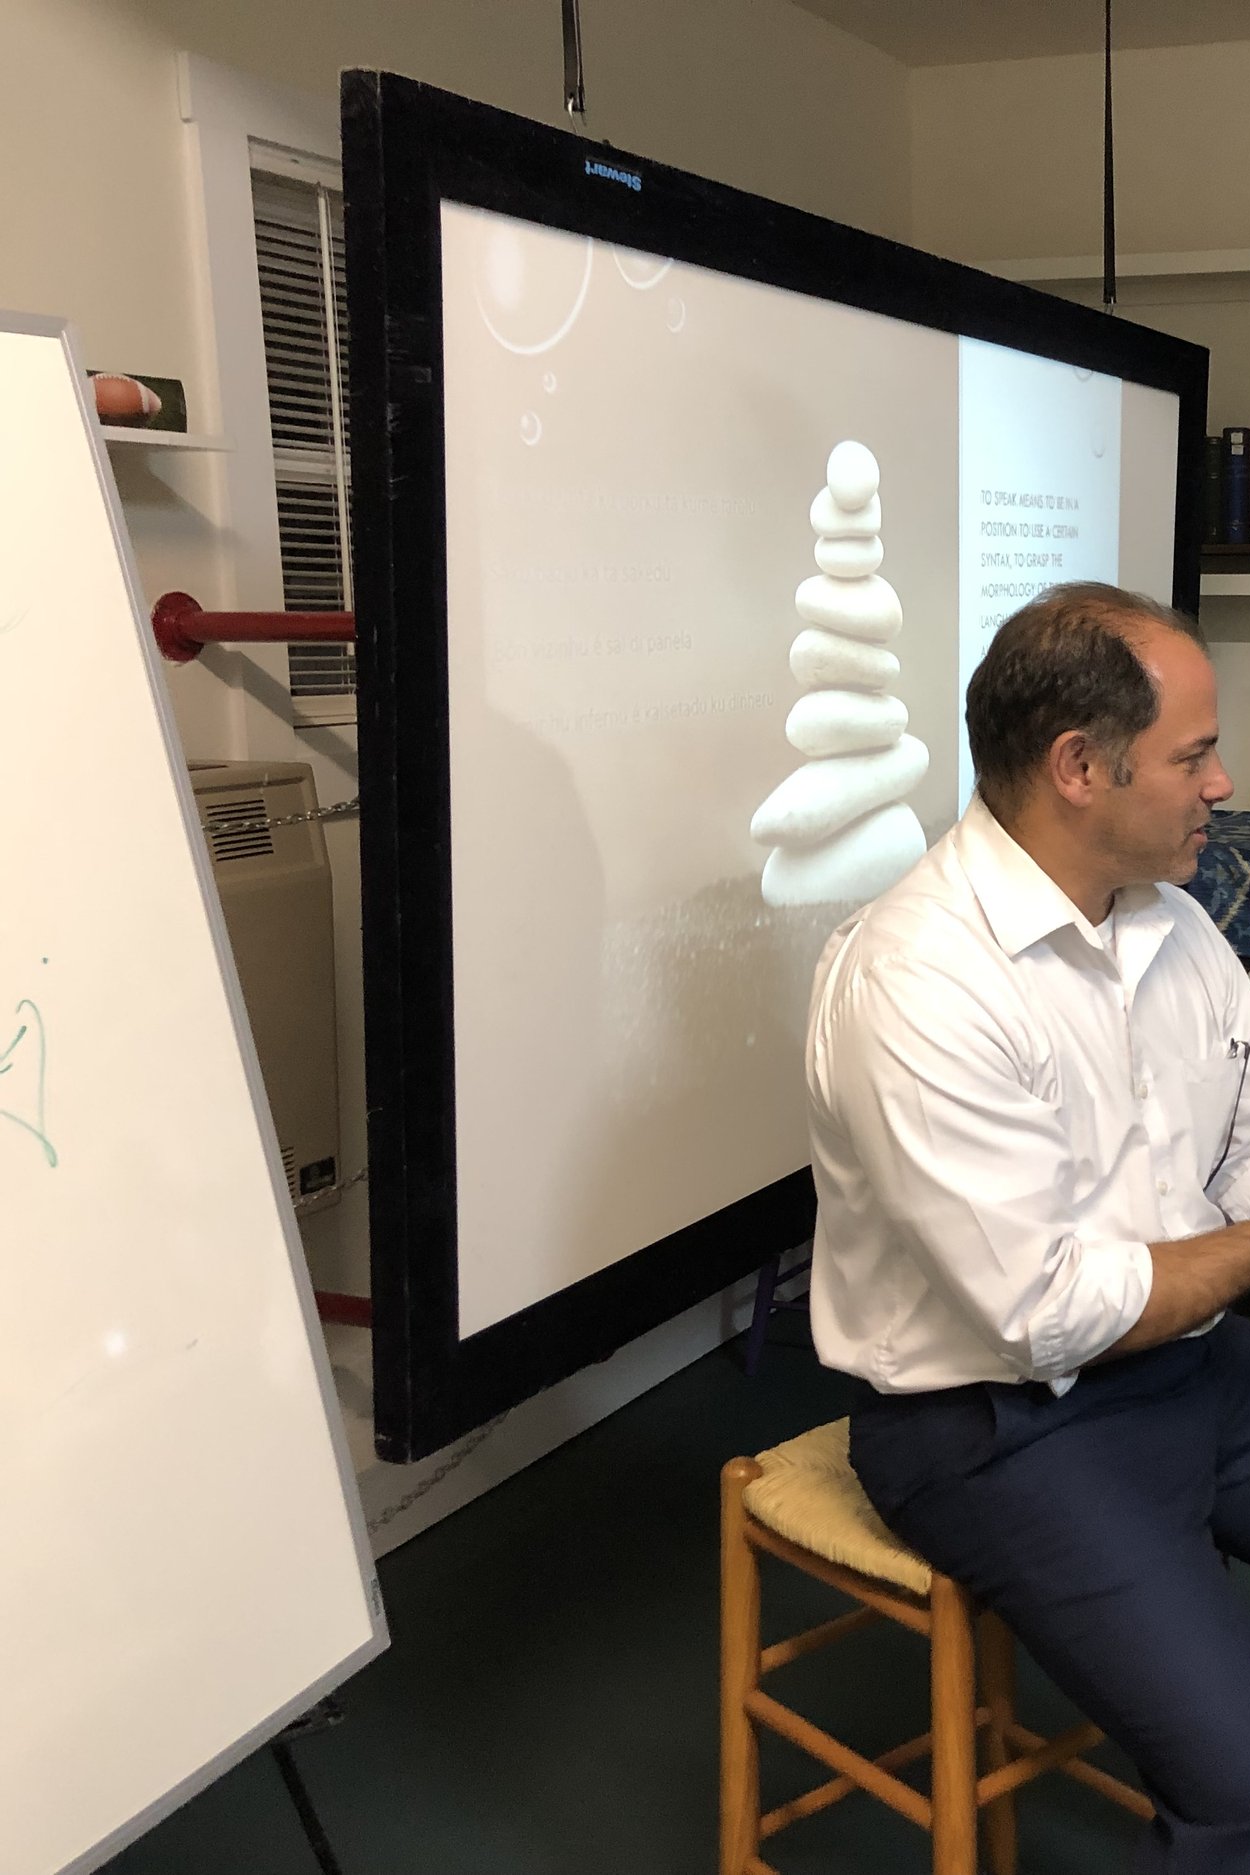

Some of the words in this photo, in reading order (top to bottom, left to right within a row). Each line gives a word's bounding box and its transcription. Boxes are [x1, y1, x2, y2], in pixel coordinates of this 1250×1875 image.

[585, 160, 642, 192] Stewart
[981, 489, 992, 506] TO
[994, 490, 1017, 508] SPEAK
[1018, 492, 1044, 510] MEANS
[1045, 494, 1056, 511] TO
[981, 521, 1018, 538] POSITION
[1019, 523, 1030, 538] TO
[1031, 523, 1044, 539] USE
[1045, 525, 1052, 538] A
[1052, 524, 1080, 539] CERTAIN
[980, 552, 1012, 570] SYNTAX,
[1014, 553, 1025, 568] TO
[1026, 553, 1050, 568] GRASP
[1051, 553, 1063, 568] THE
[980, 580, 1035, 599] MORPHOLOGY
[647, 629, 693, 656] panela
